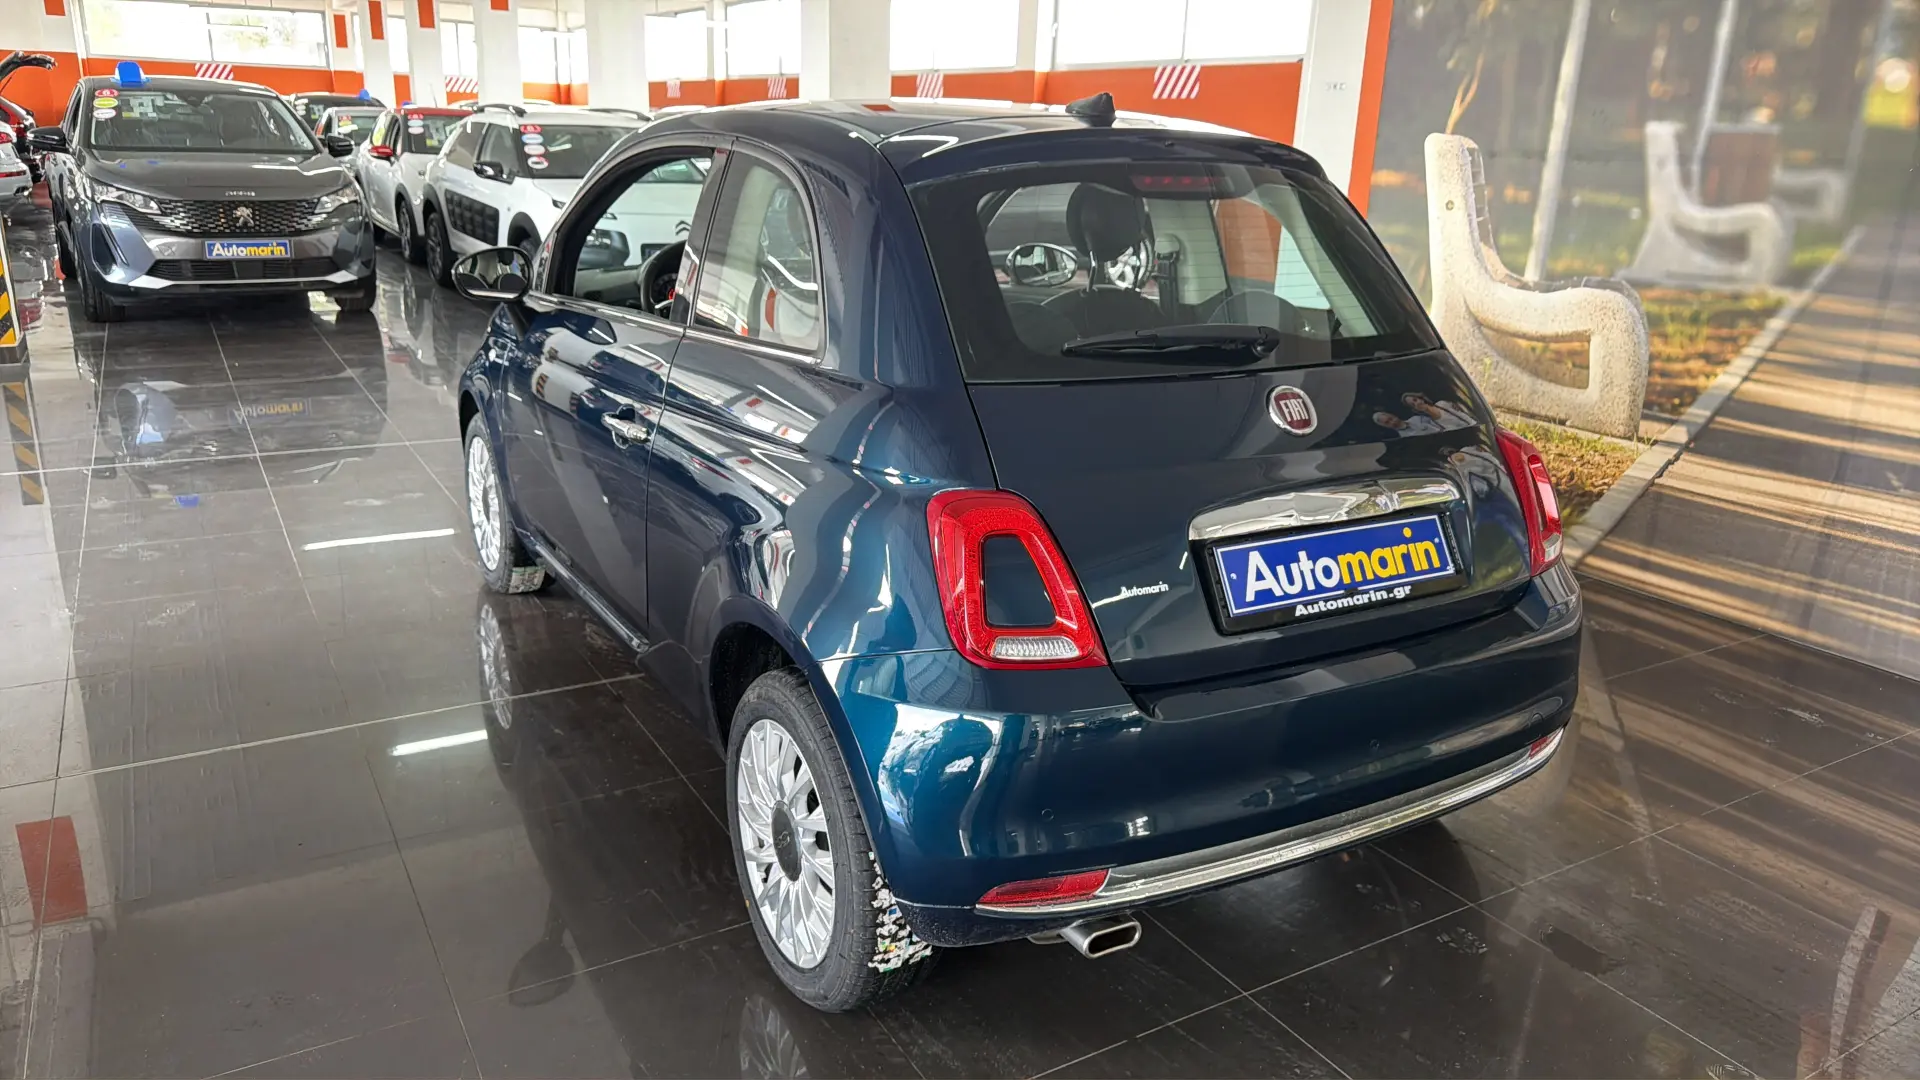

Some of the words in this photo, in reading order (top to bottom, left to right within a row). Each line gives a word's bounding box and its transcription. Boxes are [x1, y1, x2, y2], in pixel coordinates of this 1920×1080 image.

[212, 241, 286, 257] Automarin
[1279, 398, 1309, 422] FIAT
[1245, 527, 1441, 602] Automarin
[1120, 580, 1169, 598] Automarin
[1294, 584, 1412, 617] Automarin.gr
